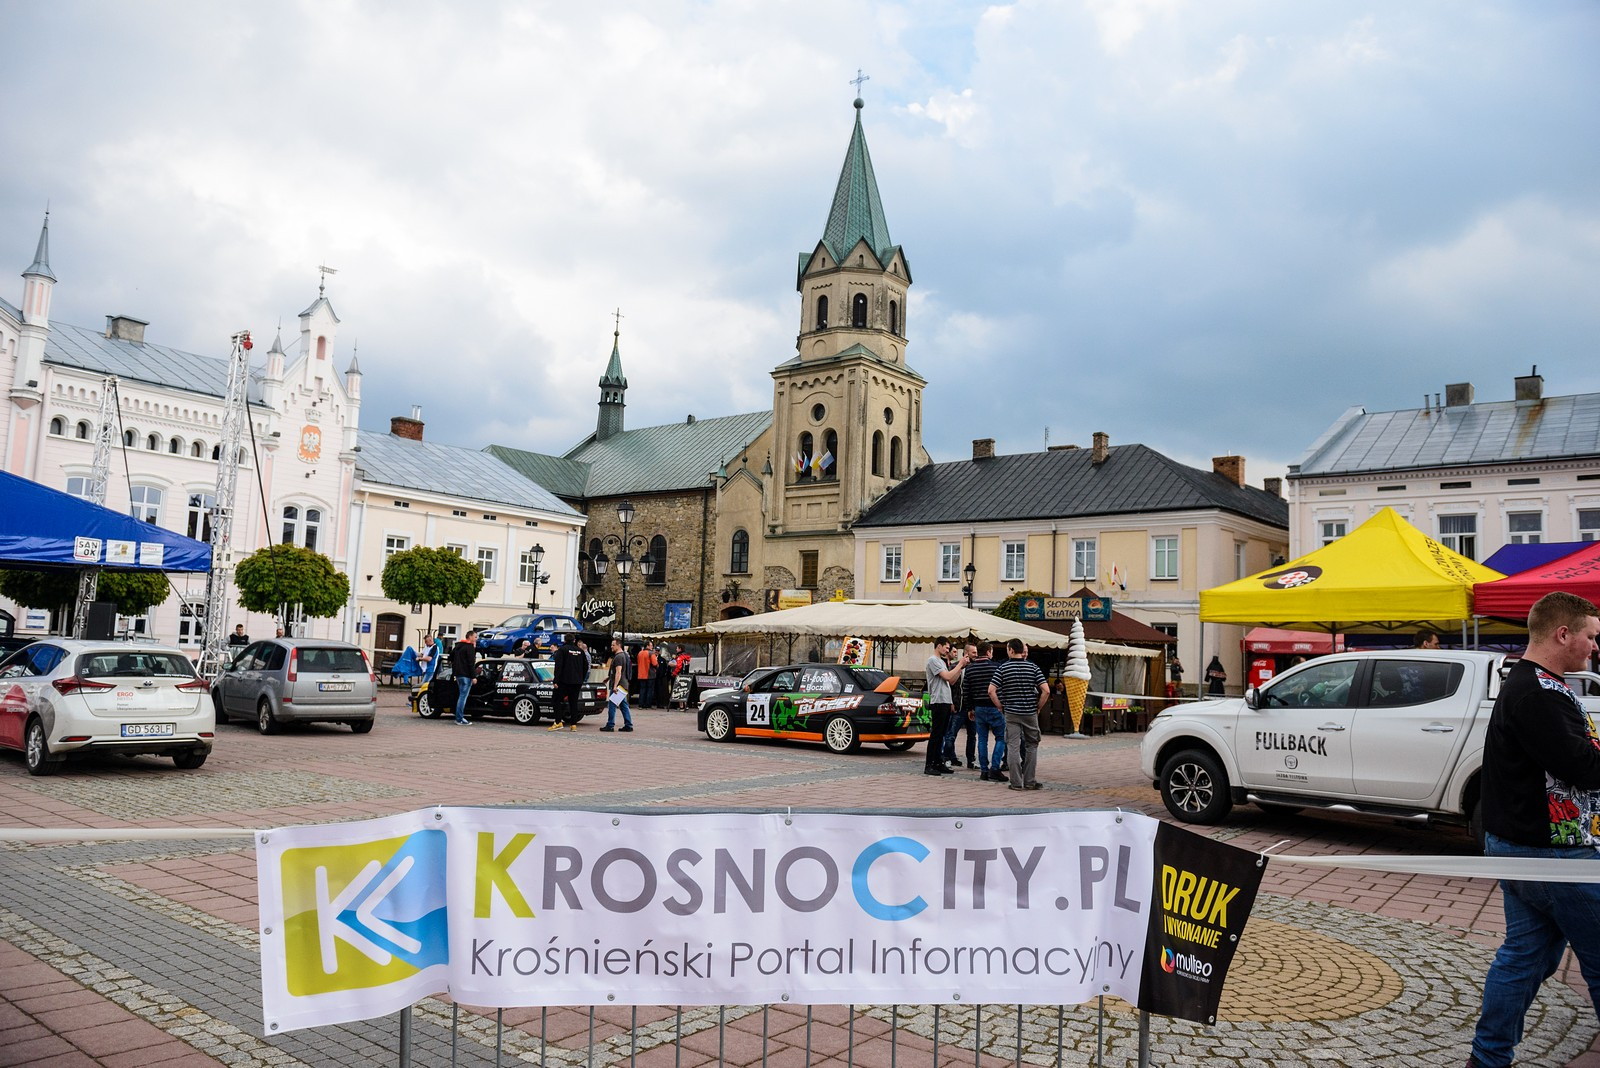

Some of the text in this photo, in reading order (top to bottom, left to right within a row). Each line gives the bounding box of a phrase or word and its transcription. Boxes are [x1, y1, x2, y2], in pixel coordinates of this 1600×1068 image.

[79, 540, 98, 549] SAN
[581, 597, 614, 619] Kawa
[1046, 600, 1080, 609] SŁODKA
[1046, 609, 1081, 618] CHATKA
[751, 704, 766, 722] 24
[128, 724, 171, 734] GD 563LF
[1255, 731, 1328, 757] FULLBACK
[1161, 864, 1241, 929] DRUK
[1167, 915, 1223, 949] WYKONANIE
[471, 936, 1134, 985] Krośnieński Portal Informacyjny
[1176, 952, 1213, 977] multeo
